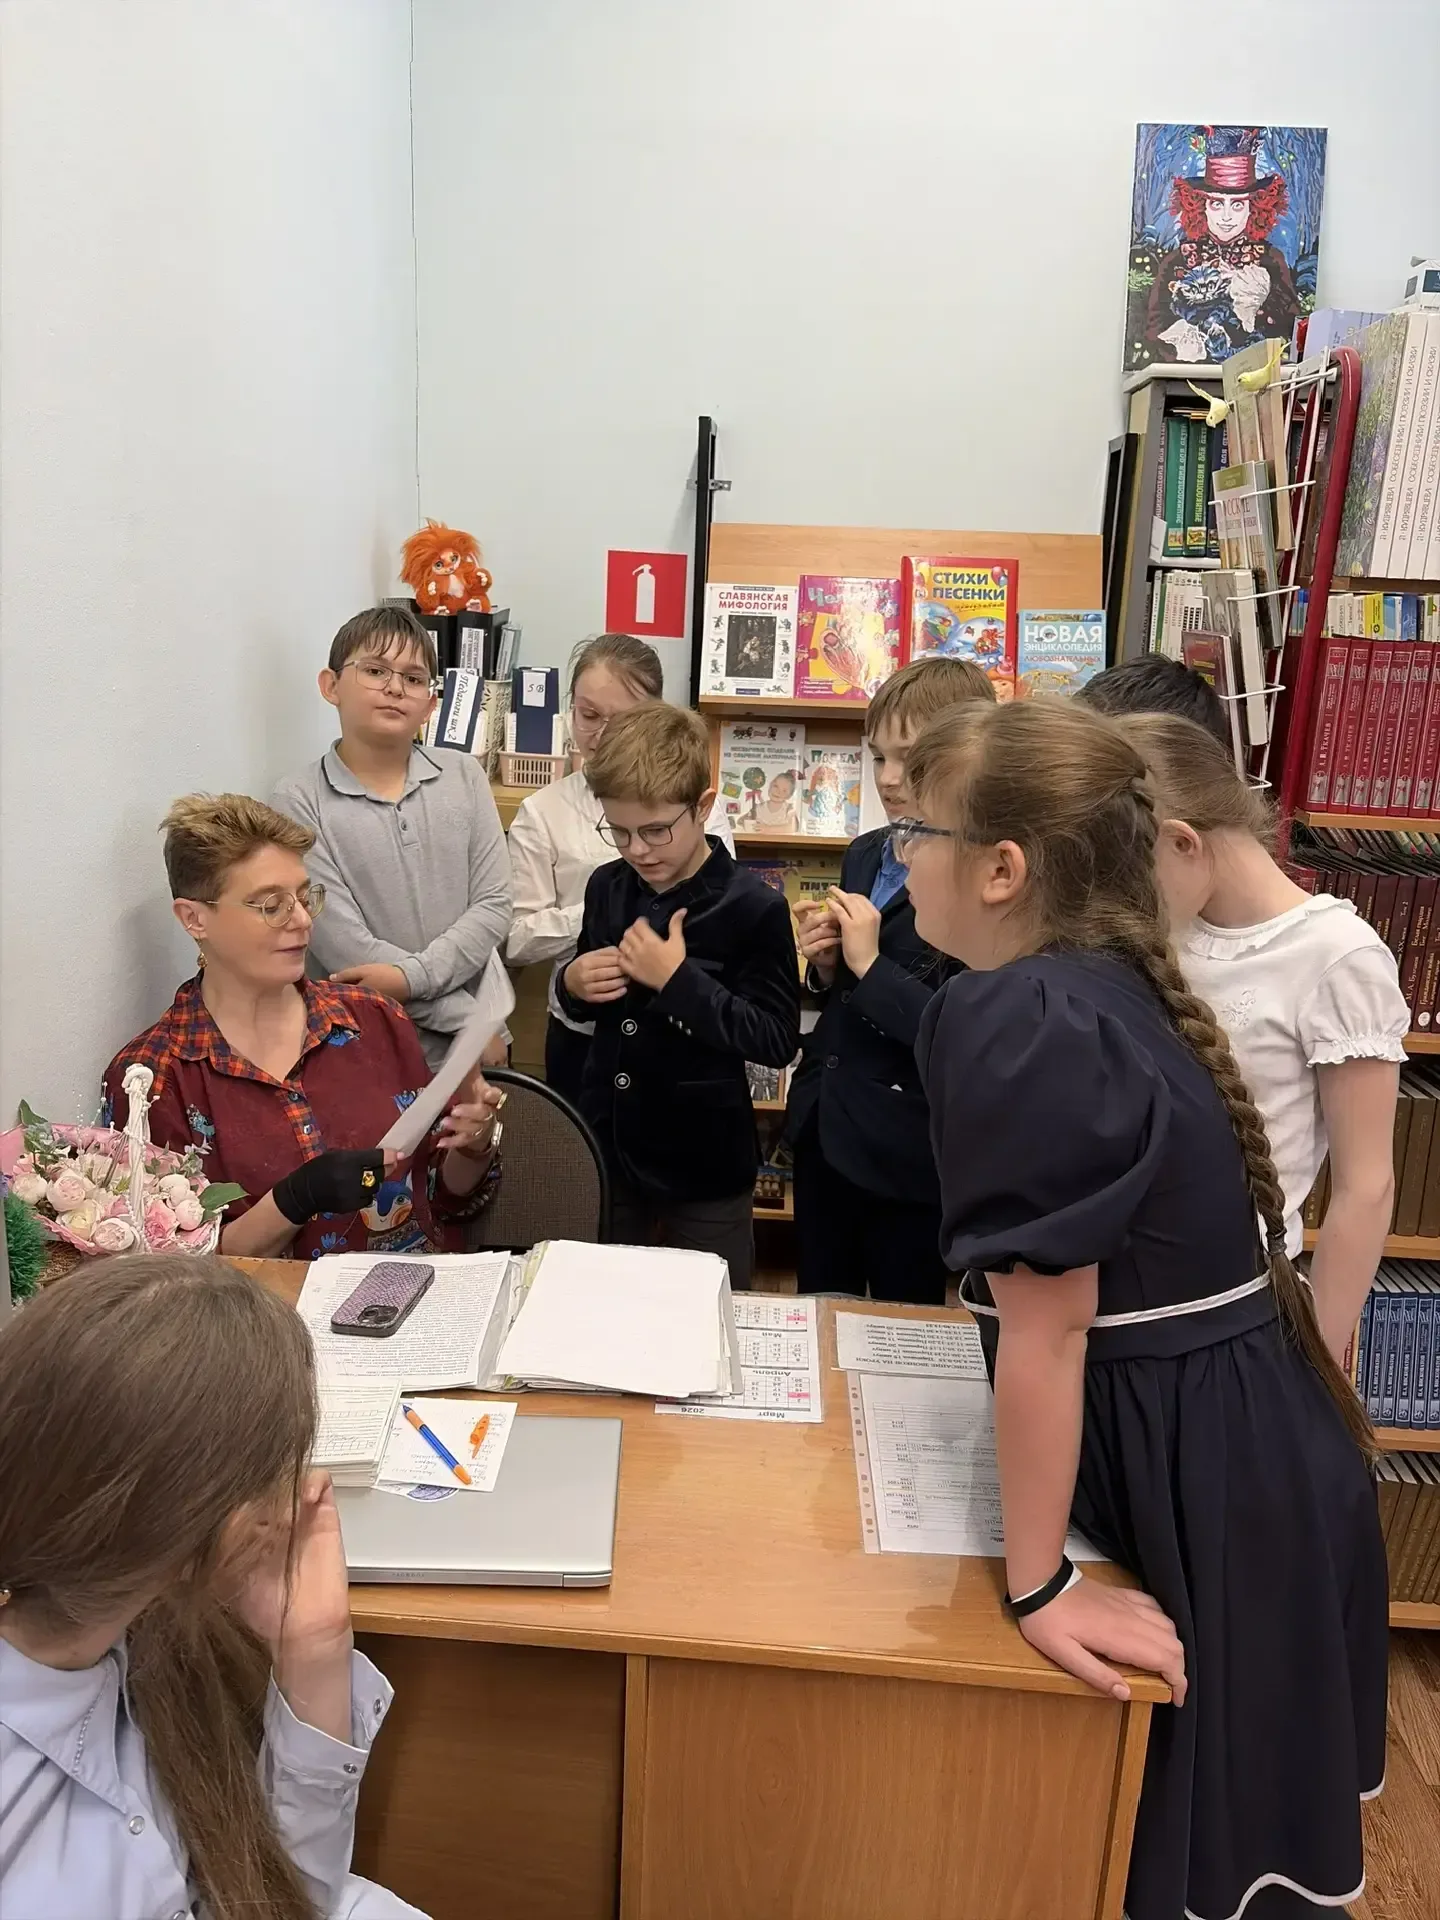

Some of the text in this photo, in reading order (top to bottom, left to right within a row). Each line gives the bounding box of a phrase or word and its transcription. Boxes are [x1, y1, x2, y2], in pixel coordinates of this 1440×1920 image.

[1389, 423, 1405, 482] СОБЕСЕДНИКИ
[1399, 387, 1412, 422] ПОЭЗИИ
[1406, 345, 1419, 377] СКАЗКИ
[1408, 424, 1424, 482] СОБЕСЕДНИКИ
[1418, 388, 1431, 422] ПОЭЗИИ
[1425, 345, 1438, 377] СКАЗКИ
[933, 571, 988, 585] СТИХИ
[718, 591, 789, 602] СЛАВЯНСКАЯ
[932, 587, 1005, 600] ПЕСЕНКИ
[718, 600, 788, 611] МИФОЛОГИЯ
[1024, 625, 1102, 643] НОВАЯ
[1023, 642, 1102, 652] ЭНЦИКЛОПЕДИЯ
[453, 675, 470, 716] Педагоги
[1411, 928, 1420, 946] Белая
[1419, 952, 1436, 1005] Гражданская война
